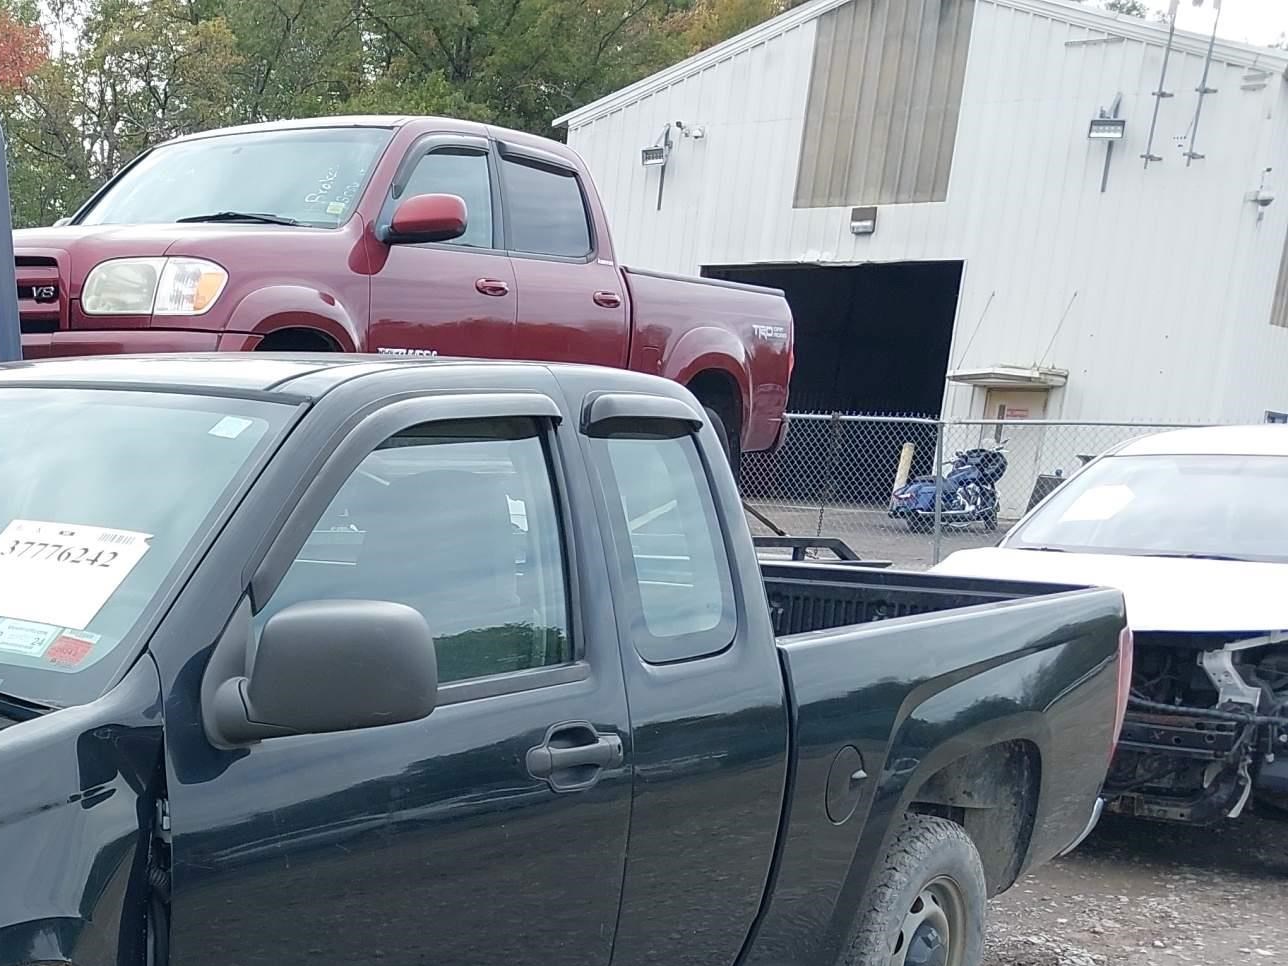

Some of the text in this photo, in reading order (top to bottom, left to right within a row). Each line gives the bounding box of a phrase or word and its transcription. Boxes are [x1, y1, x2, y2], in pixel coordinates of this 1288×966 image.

[32, 286, 55, 298] V8
[752, 324, 773, 341] TRD
[0, 539, 118, 568] 37776242
